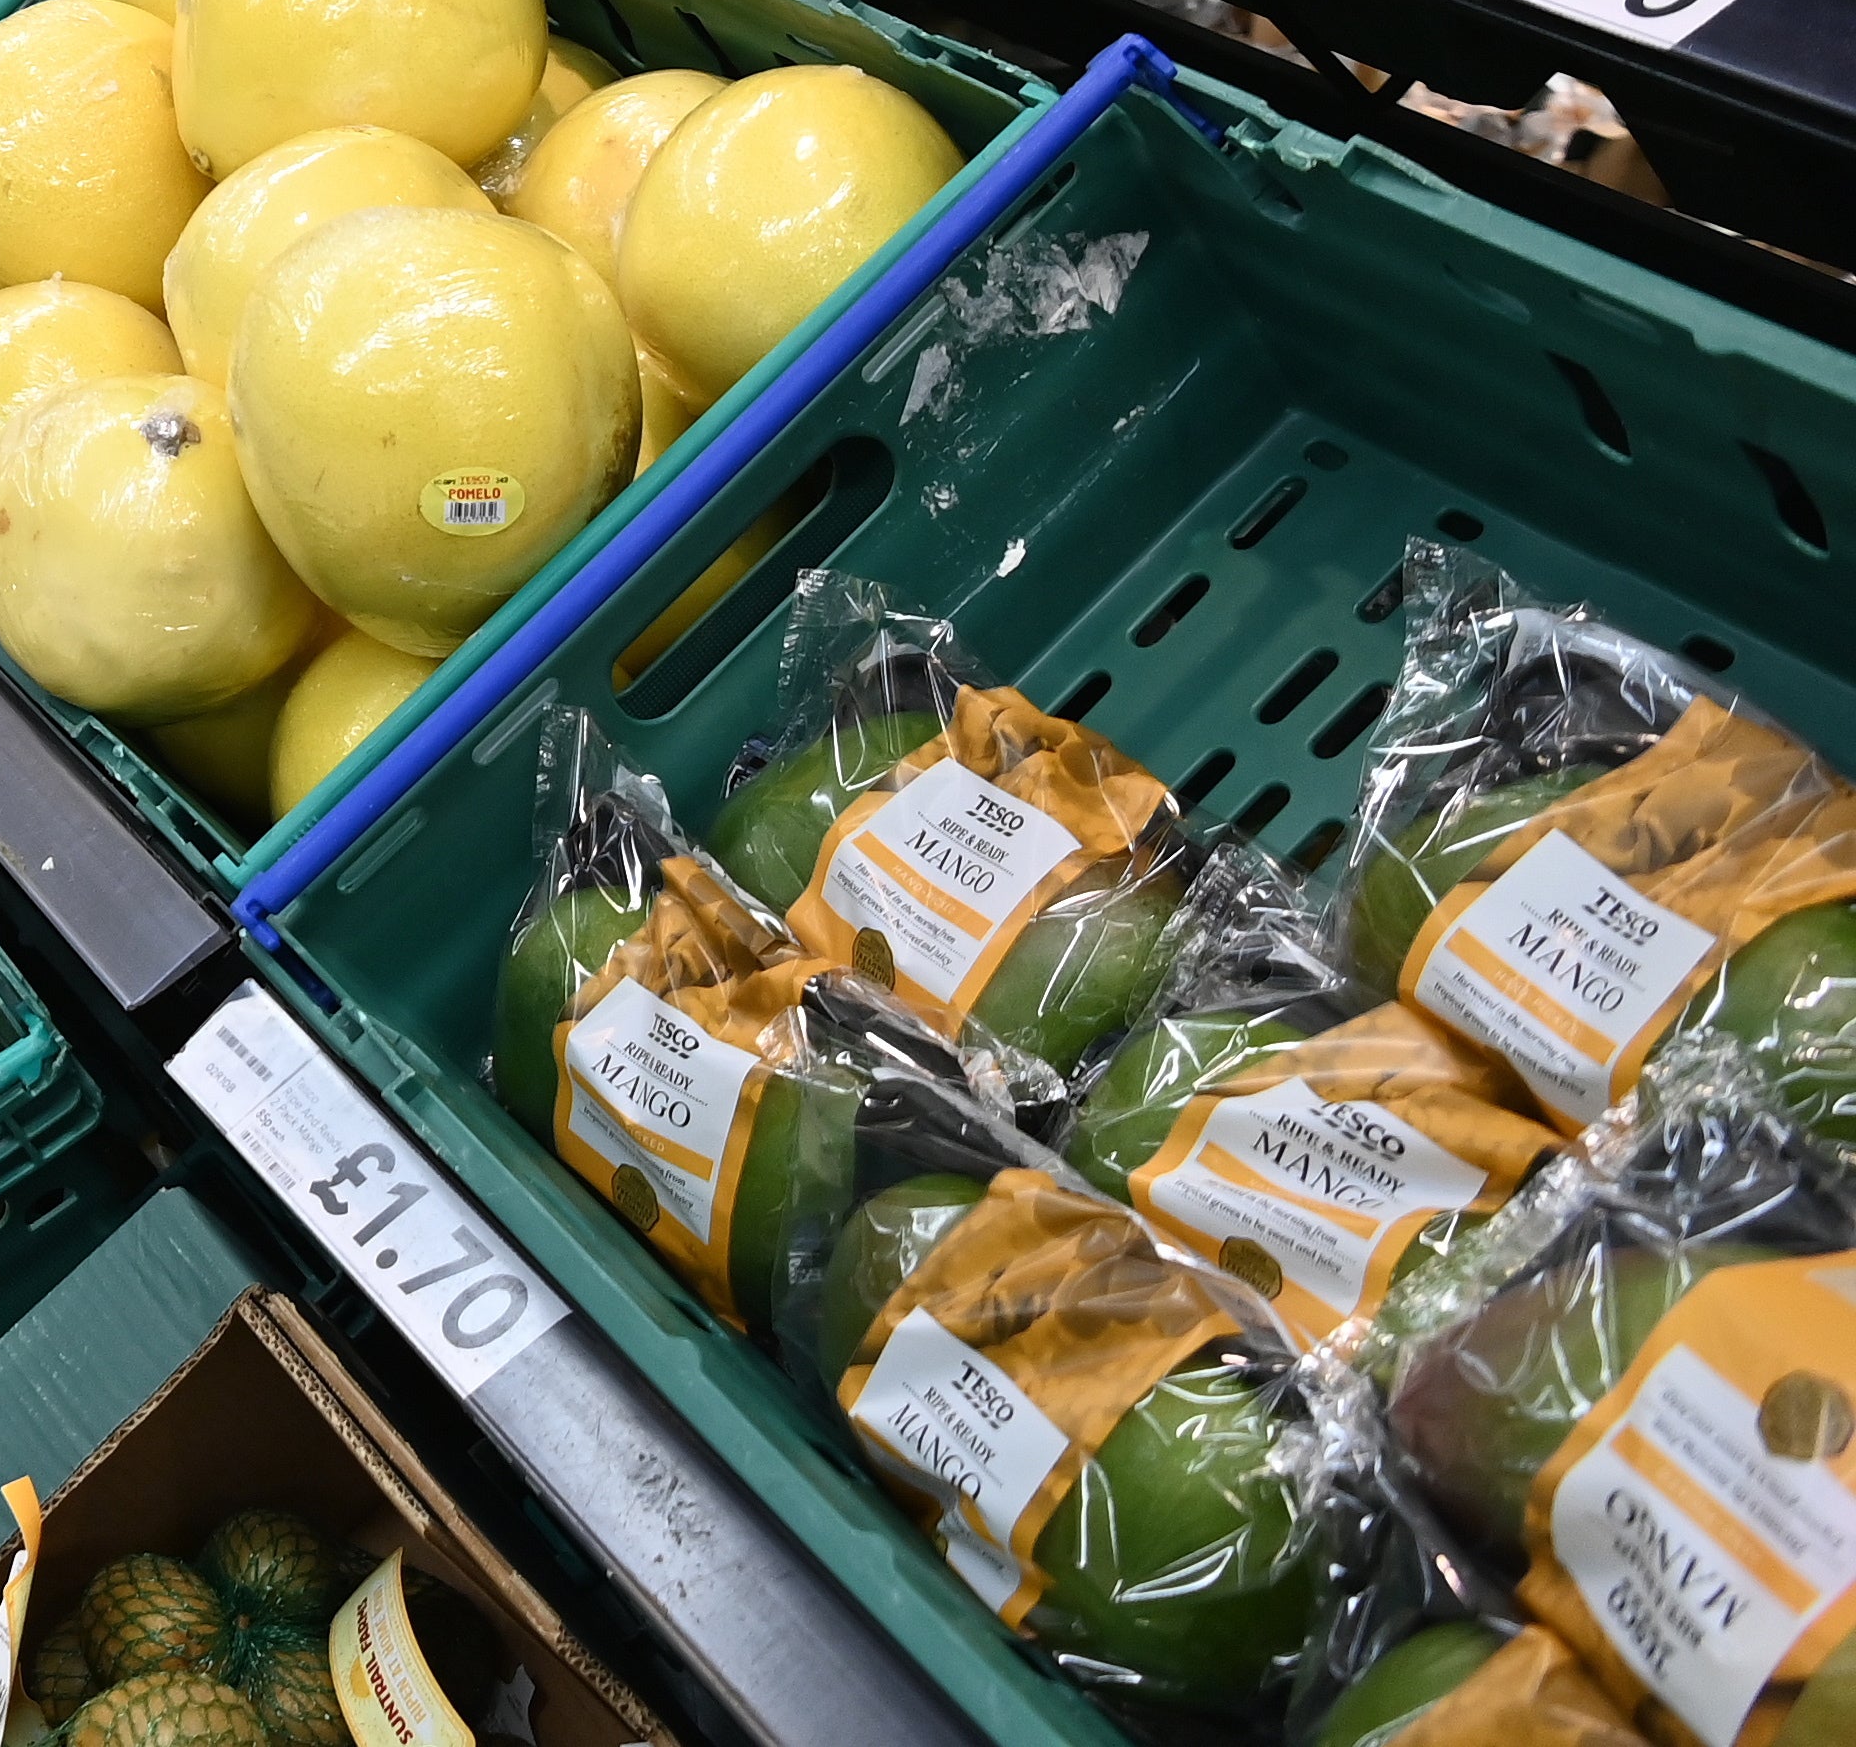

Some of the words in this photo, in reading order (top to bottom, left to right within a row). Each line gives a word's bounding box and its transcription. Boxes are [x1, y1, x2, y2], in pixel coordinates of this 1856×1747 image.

[448, 487, 501, 500] POMELO
[460, 475, 491, 485] TESCO
[938, 816, 968, 842] RIPE
[973, 837, 1010, 865] READY
[972, 793, 1026, 832] TESCO
[904, 828, 996, 895] MANGO
[914, 907, 943, 936] morning
[938, 925, 957, 946] from
[1593, 885, 1660, 939] TESCO
[934, 945, 953, 967] juicy
[1505, 923, 1625, 1014] MANGO
[1548, 908, 1589, 943] RIPE
[1595, 942, 1643, 979] READY
[652, 1013, 700, 1051] TESCO
[1434, 980, 1466, 1014] tropical
[1461, 1005, 1493, 1038] groves
[1453, 970, 1501, 1013] Harvested
[1520, 1021, 1559, 1059] morning
[295, 1076, 320, 1105] Tesco
[591, 1052, 692, 1129] MANGO
[624, 1041, 651, 1068] RIPE
[653, 1060, 694, 1092] READY
[255, 1108, 273, 1129] 85p
[269, 1125, 286, 1143] each
[275, 1102, 298, 1129] Pack
[297, 1122, 324, 1155] Mango
[283, 1087, 302, 1111] Ripe
[301, 1107, 319, 1128] And
[319, 1123, 344, 1153] Ready
[1318, 1100, 1406, 1159] TESCO
[1252, 1129, 1386, 1209] MANGO
[1276, 1113, 1319, 1147] RIPE
[1339, 1149, 1406, 1192] READY
[309, 1141, 530, 1350] £1.70
[1208, 1198, 1242, 1221] groves
[1265, 1224, 1296, 1247] sweet
[1293, 1240, 1318, 1260] and
[1315, 1251, 1343, 1274] juicy
[1271, 1203, 1315, 1233] morning
[1309, 1224, 1339, 1246] from
[959, 1359, 1015, 1423] TESCO
[886, 1402, 983, 1501] MANGO
[923, 1386, 951, 1420] RIPE
[952, 1415, 996, 1465] READY
[1604, 1487, 1751, 1630] MANGO
[357, 1596, 373, 1654] FARMS
[375, 1618, 395, 1658] HOME
[1605, 1576, 1674, 1680] TESCO
[388, 1658, 403, 1678] AT
[365, 1651, 414, 1746] SUNTRAIL
[396, 1677, 427, 1724] RIPEN
